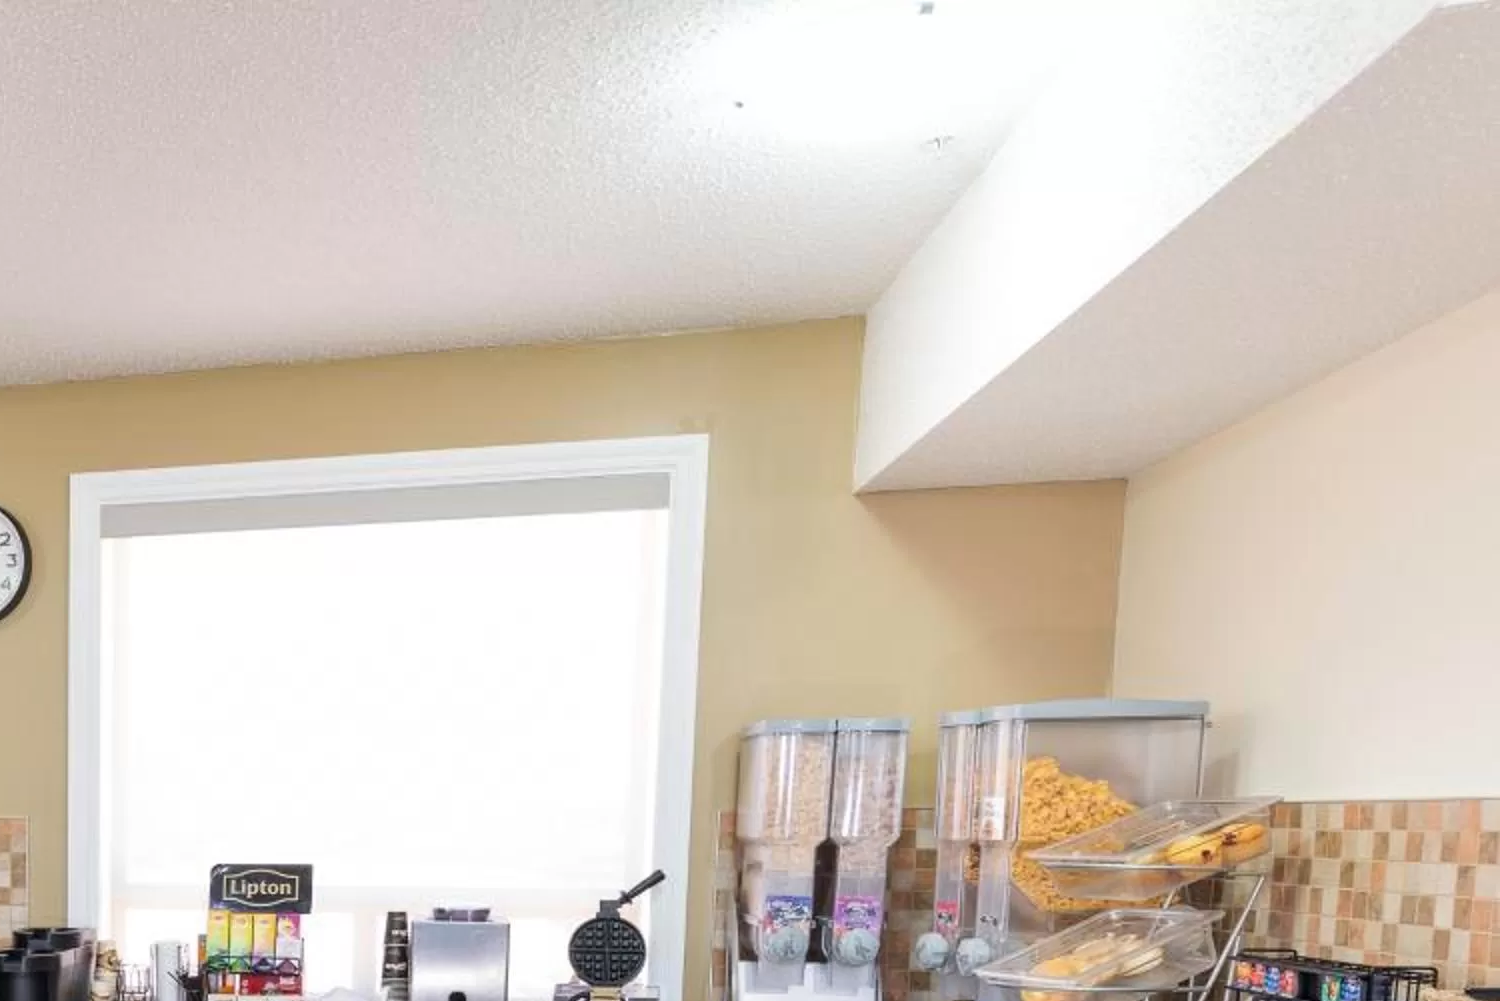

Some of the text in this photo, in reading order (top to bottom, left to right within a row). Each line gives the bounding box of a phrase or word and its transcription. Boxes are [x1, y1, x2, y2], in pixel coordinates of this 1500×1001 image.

[0, 532, 12, 547] 2
[6, 553, 18, 568] 3
[0, 576, 12, 590] 4
[229, 879, 293, 898] Lipton
